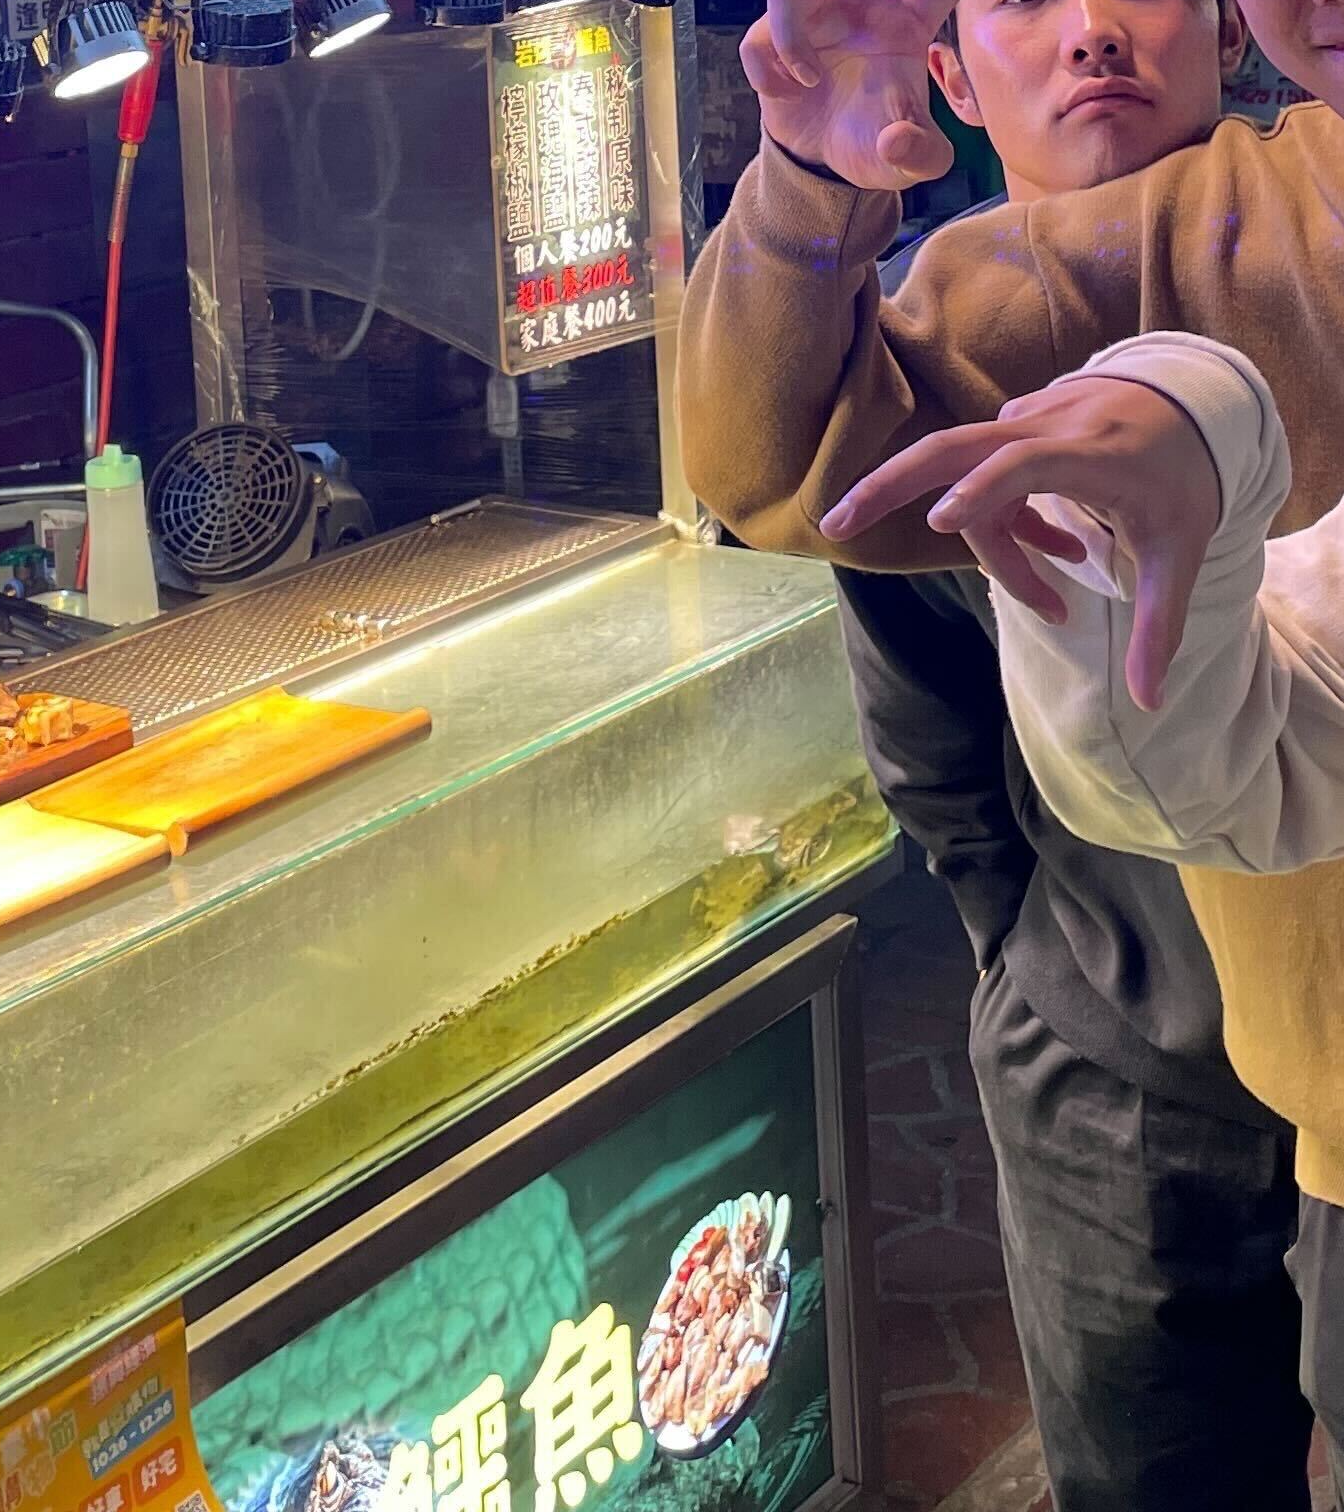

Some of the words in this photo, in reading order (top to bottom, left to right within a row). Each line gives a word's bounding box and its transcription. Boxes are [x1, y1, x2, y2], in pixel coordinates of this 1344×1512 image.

[502, 86, 534, 242] 檸檬椒鹽
[537, 79, 568, 233] 玫瑰海鹽
[573, 70, 603, 223] 泰式酸辣
[519, 289, 636, 352] 家庭餐400元
